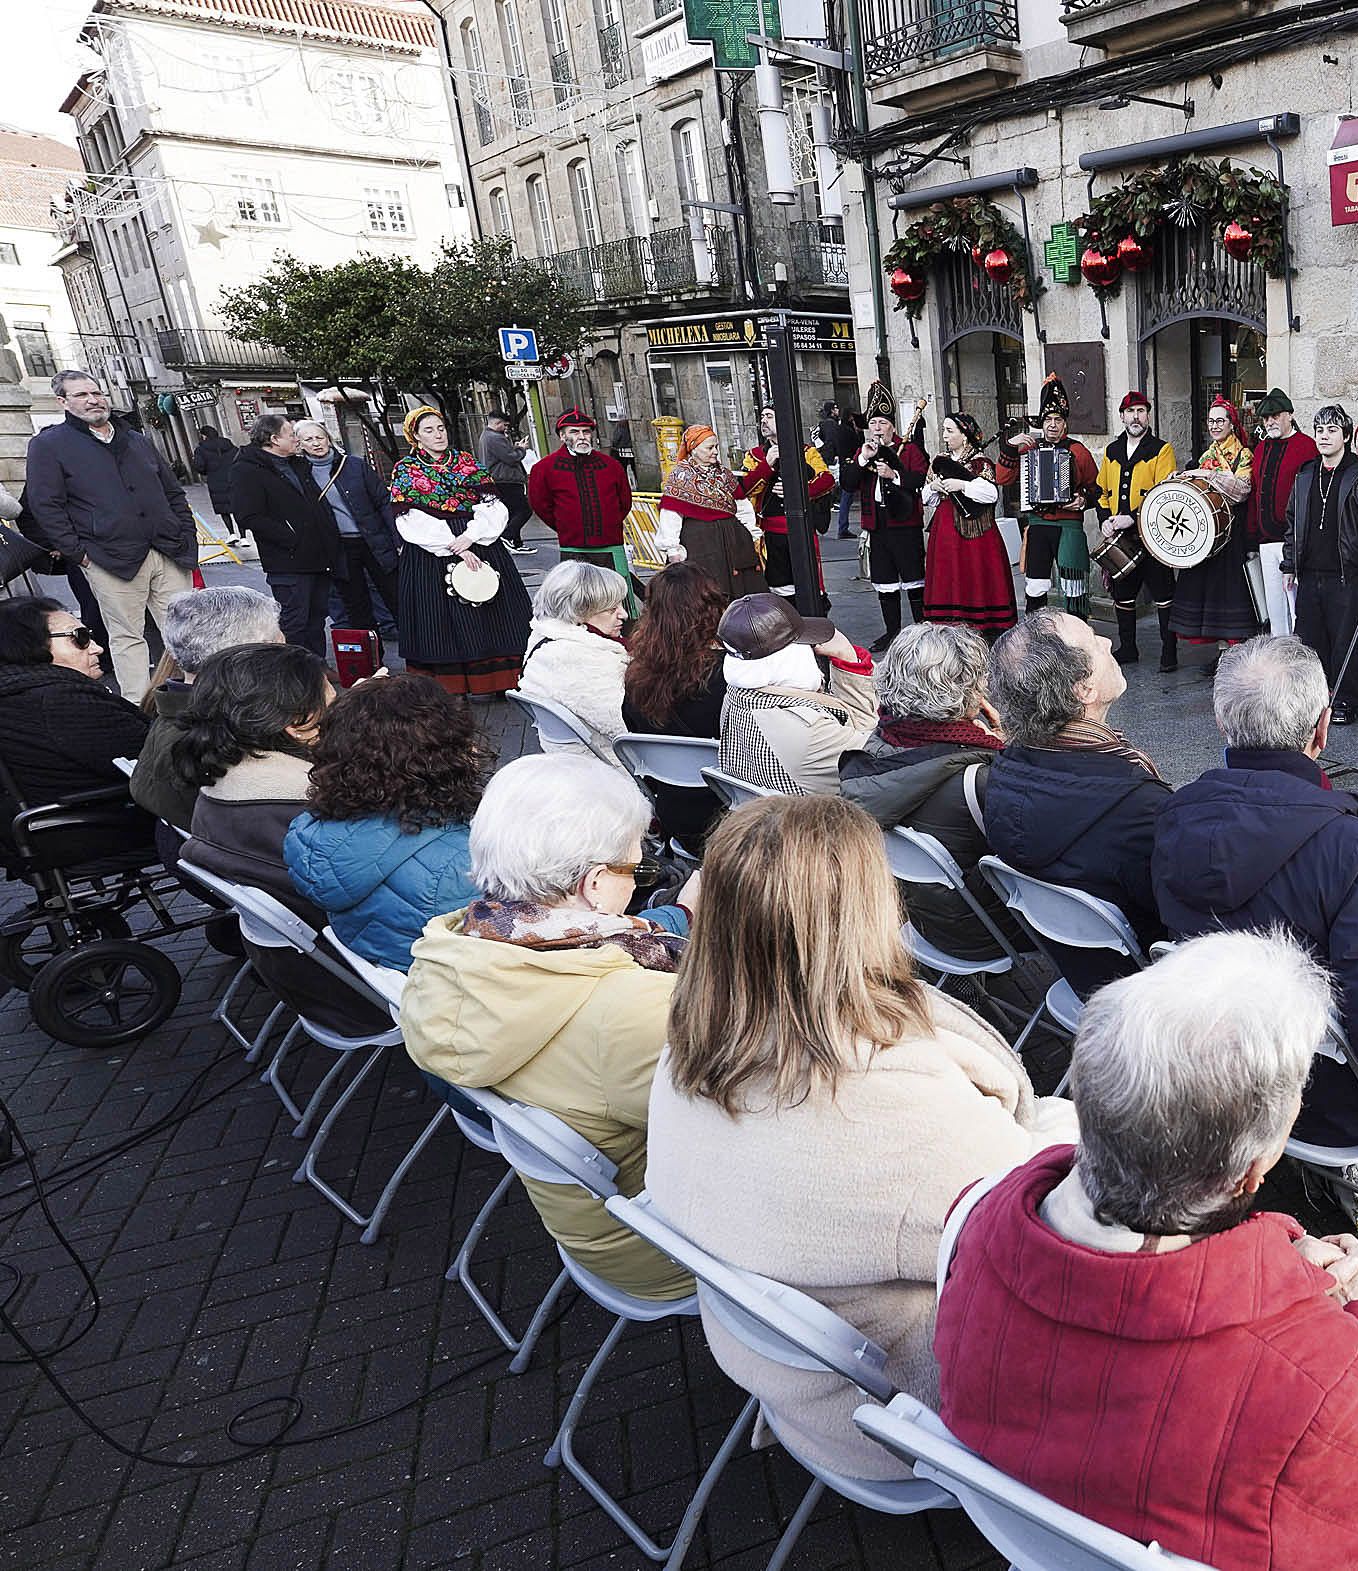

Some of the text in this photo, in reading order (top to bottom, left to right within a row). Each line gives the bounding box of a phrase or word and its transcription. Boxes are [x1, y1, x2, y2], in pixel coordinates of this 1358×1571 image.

[648, 324, 709, 346] MICHELENA
[792, 333, 816, 341] SPASOS
[831, 321, 850, 338] M
[508, 333, 529, 356] P
[178, 391, 213, 404] LA CATA
